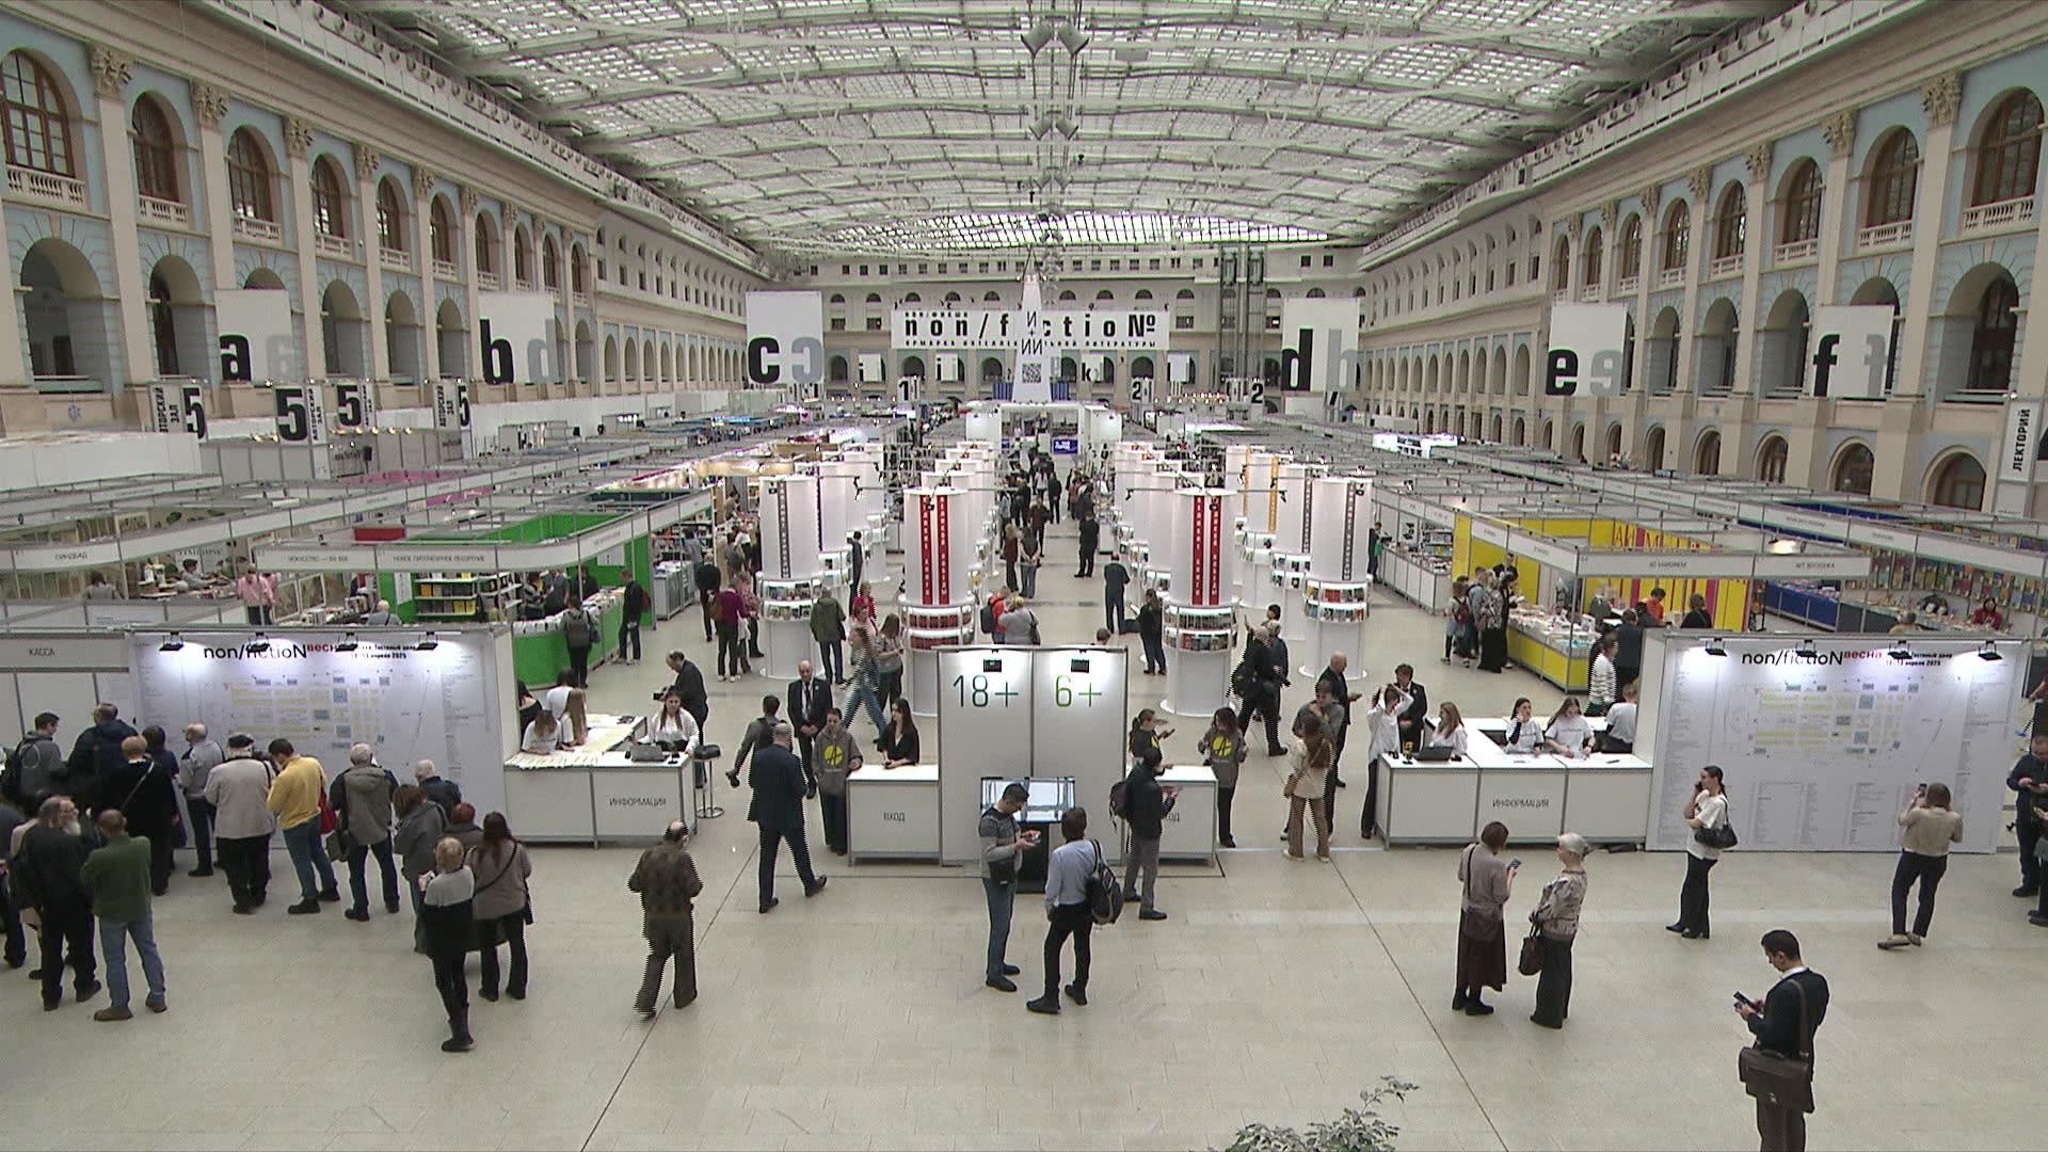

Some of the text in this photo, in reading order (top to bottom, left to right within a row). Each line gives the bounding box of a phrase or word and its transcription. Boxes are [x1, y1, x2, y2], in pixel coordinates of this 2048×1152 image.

[219, 334, 251, 382] a
[480, 319, 513, 384] b
[748, 337, 780, 384] c
[1281, 328, 1313, 391] d
[1546, 349, 1578, 396] e
[1812, 334, 1840, 397] f
[337, 384, 362, 426] 5
[458, 385, 470, 427] 5
[898, 381, 908, 401] 1
[1132, 382, 1141, 400] 2
[1252, 383, 1263, 404] 2
[182, 387, 205, 439] 5
[275, 388, 308, 441] 5
[2013, 408, 2030, 472] ЛЕКТОРИЙ
[29, 648, 54, 656] КАССА
[953, 674, 1019, 707] 18+
[1056, 674, 1102, 707] 6+
[609, 798, 667, 807] ИНФОРМАЦИЯ
[883, 812, 905, 822] ВХОД
[1492, 799, 1549, 808] ИНФОРМАЦИЯ
